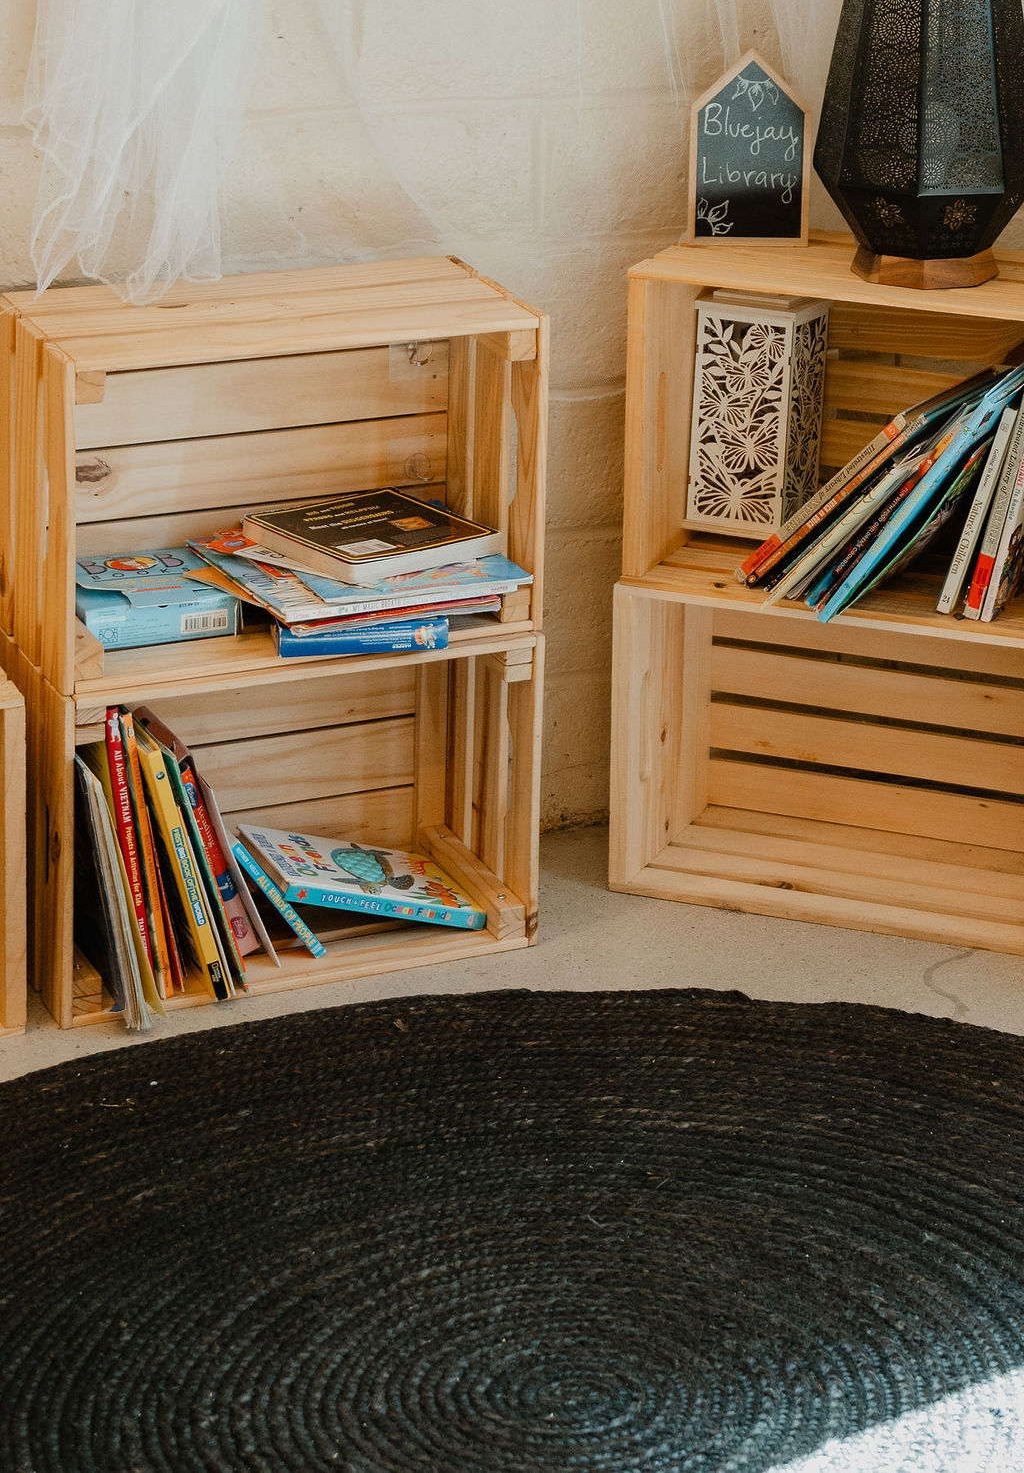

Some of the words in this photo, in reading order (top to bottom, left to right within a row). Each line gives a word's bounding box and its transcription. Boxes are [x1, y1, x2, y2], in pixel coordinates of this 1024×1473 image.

[703, 102, 799, 162] Bluejay
[702, 156, 798, 204] Library
[849, 443, 876, 474] Illustrated
[1004, 451, 1017, 487] Library
[824, 469, 848, 493] Library
[897, 486, 908, 498] FUN
[785, 498, 821, 533] NATURE
[876, 507, 890, 523] FOOD
[887, 495, 901, 510] WITH
[964, 499, 983, 536] Nature's
[989, 494, 1008, 545] NATURE
[854, 520, 880, 549] CHILDREN'S
[833, 545, 858, 574] COOKBOOK
[950, 538, 970, 575] Children
[942, 595, 951, 604] 24
[114, 750, 123, 761] All
[115, 762, 125, 786] About
[119, 786, 132, 823] VIETNAM
[125, 825, 135, 850] Projects
[172, 827, 183, 847] FIRST
[197, 805, 215, 849] Reading
[177, 847, 187, 860] BIG
[277, 843, 320, 877] Ocean
[287, 834, 338, 873] Friends
[130, 856, 140, 884] Activities
[181, 859, 193, 878] BOOK
[186, 877, 195, 888] OF
[134, 893, 143, 907] Kids
[188, 887, 199, 902] THE
[320, 893, 353, 906] TOUCH
[359, 898, 381, 911] FEEL
[383, 902, 415, 916] Ocean
[415, 907, 452, 922] Friends
[192, 901, 206, 925] WORLD
[256, 875, 271, 891] ALL
[267, 887, 289, 912] KINDS
[284, 906, 297, 923] OF
[292, 918, 317, 946] PEOPLE
